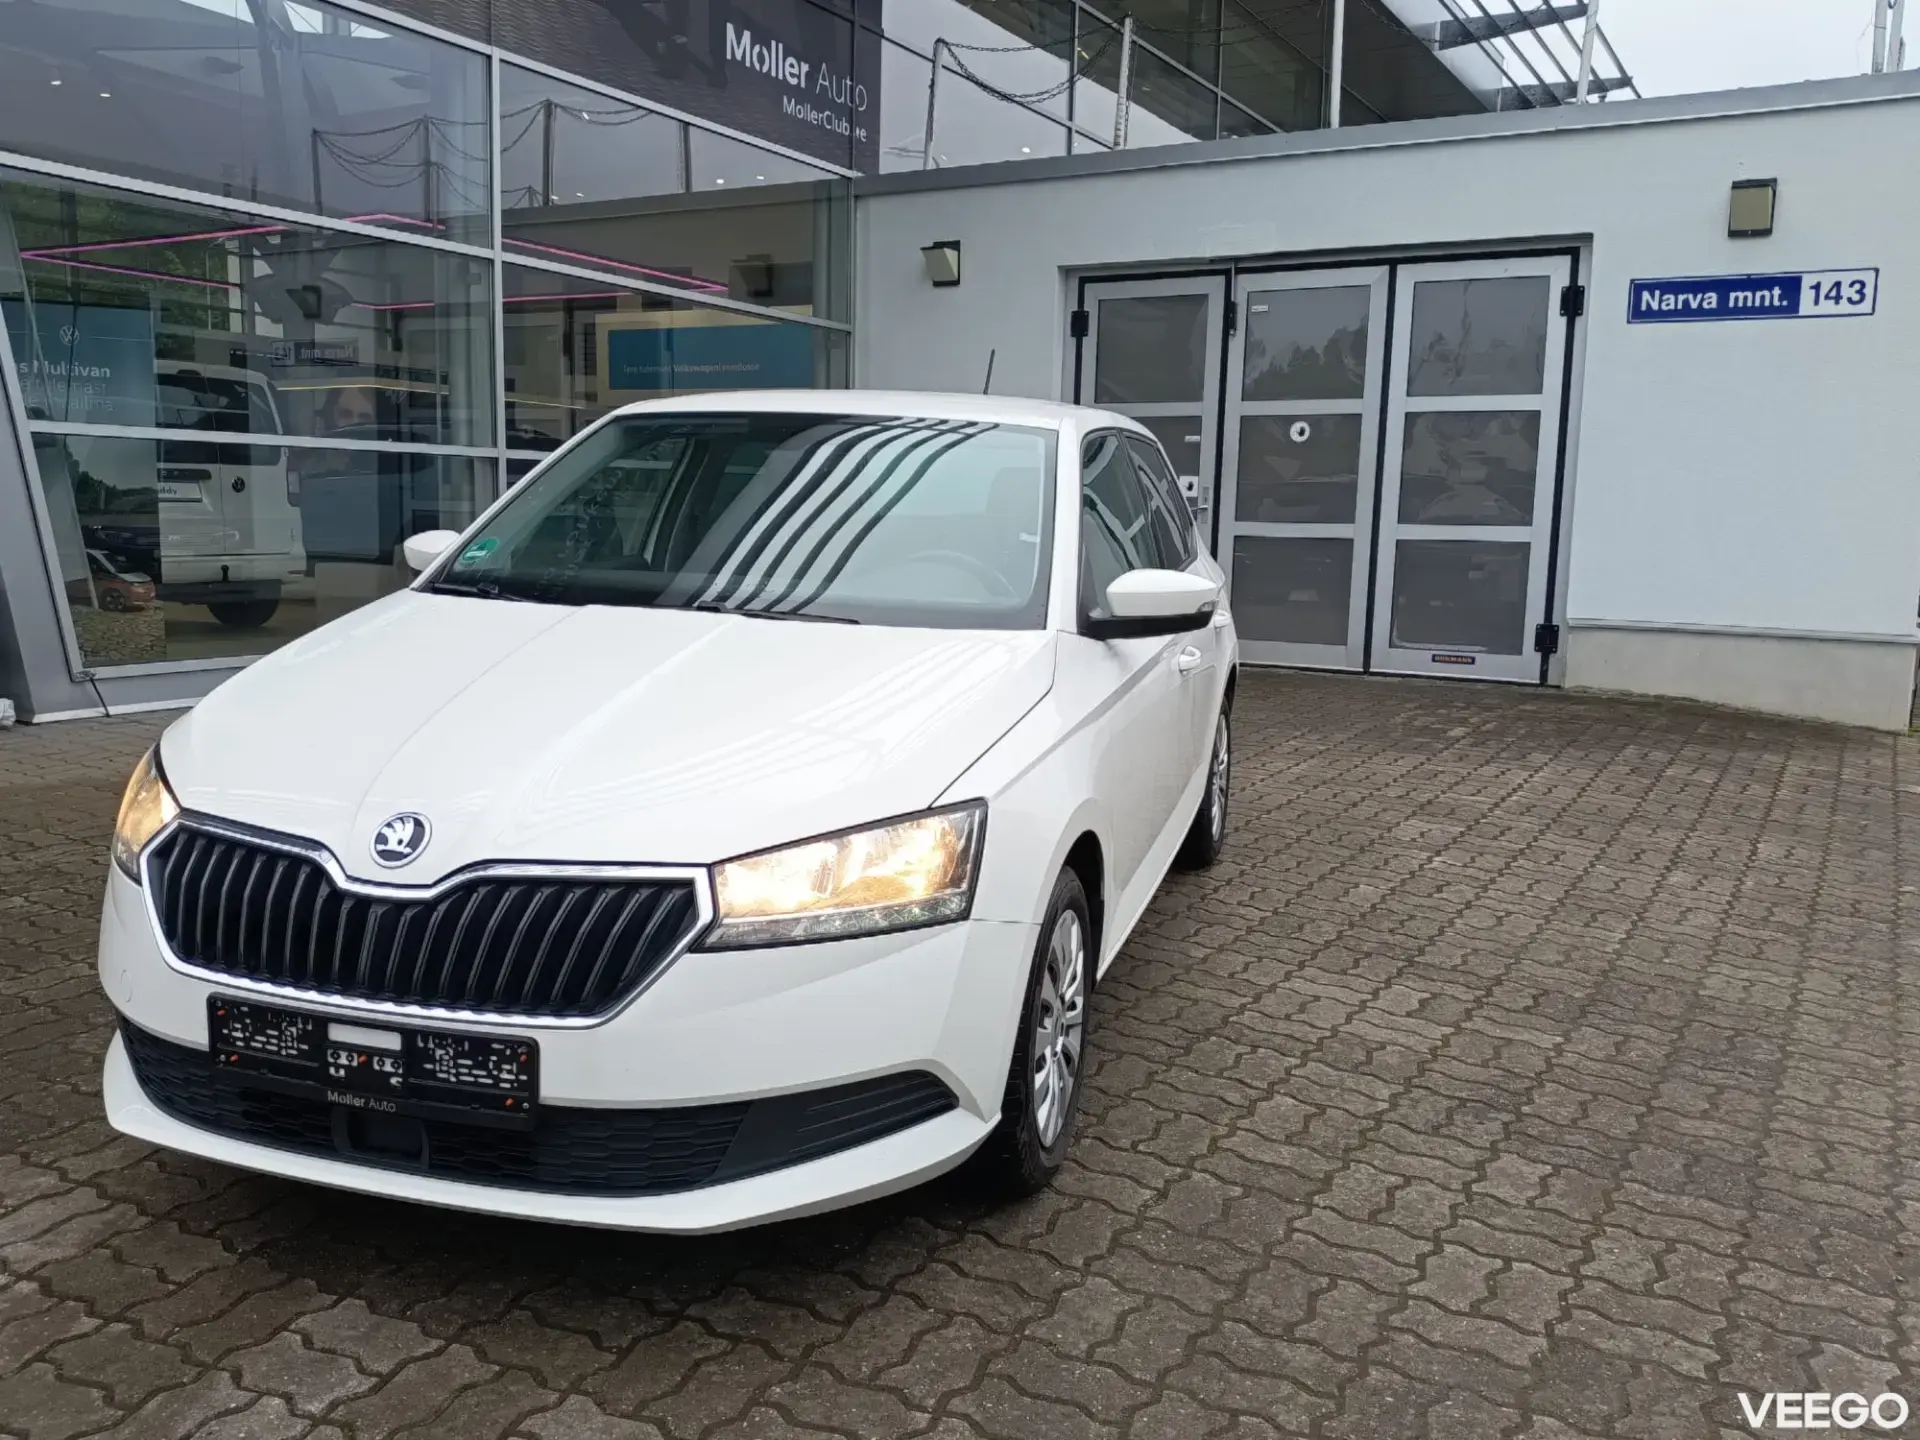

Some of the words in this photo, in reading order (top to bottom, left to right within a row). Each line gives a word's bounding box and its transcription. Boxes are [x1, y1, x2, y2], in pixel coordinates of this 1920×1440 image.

[815, 62, 868, 111] Auto
[1640, 289, 1718, 312] Narva
[1728, 285, 1789, 308] mnt.
[1808, 279, 1867, 306] 143
[368, 1098, 397, 1112] Auto
